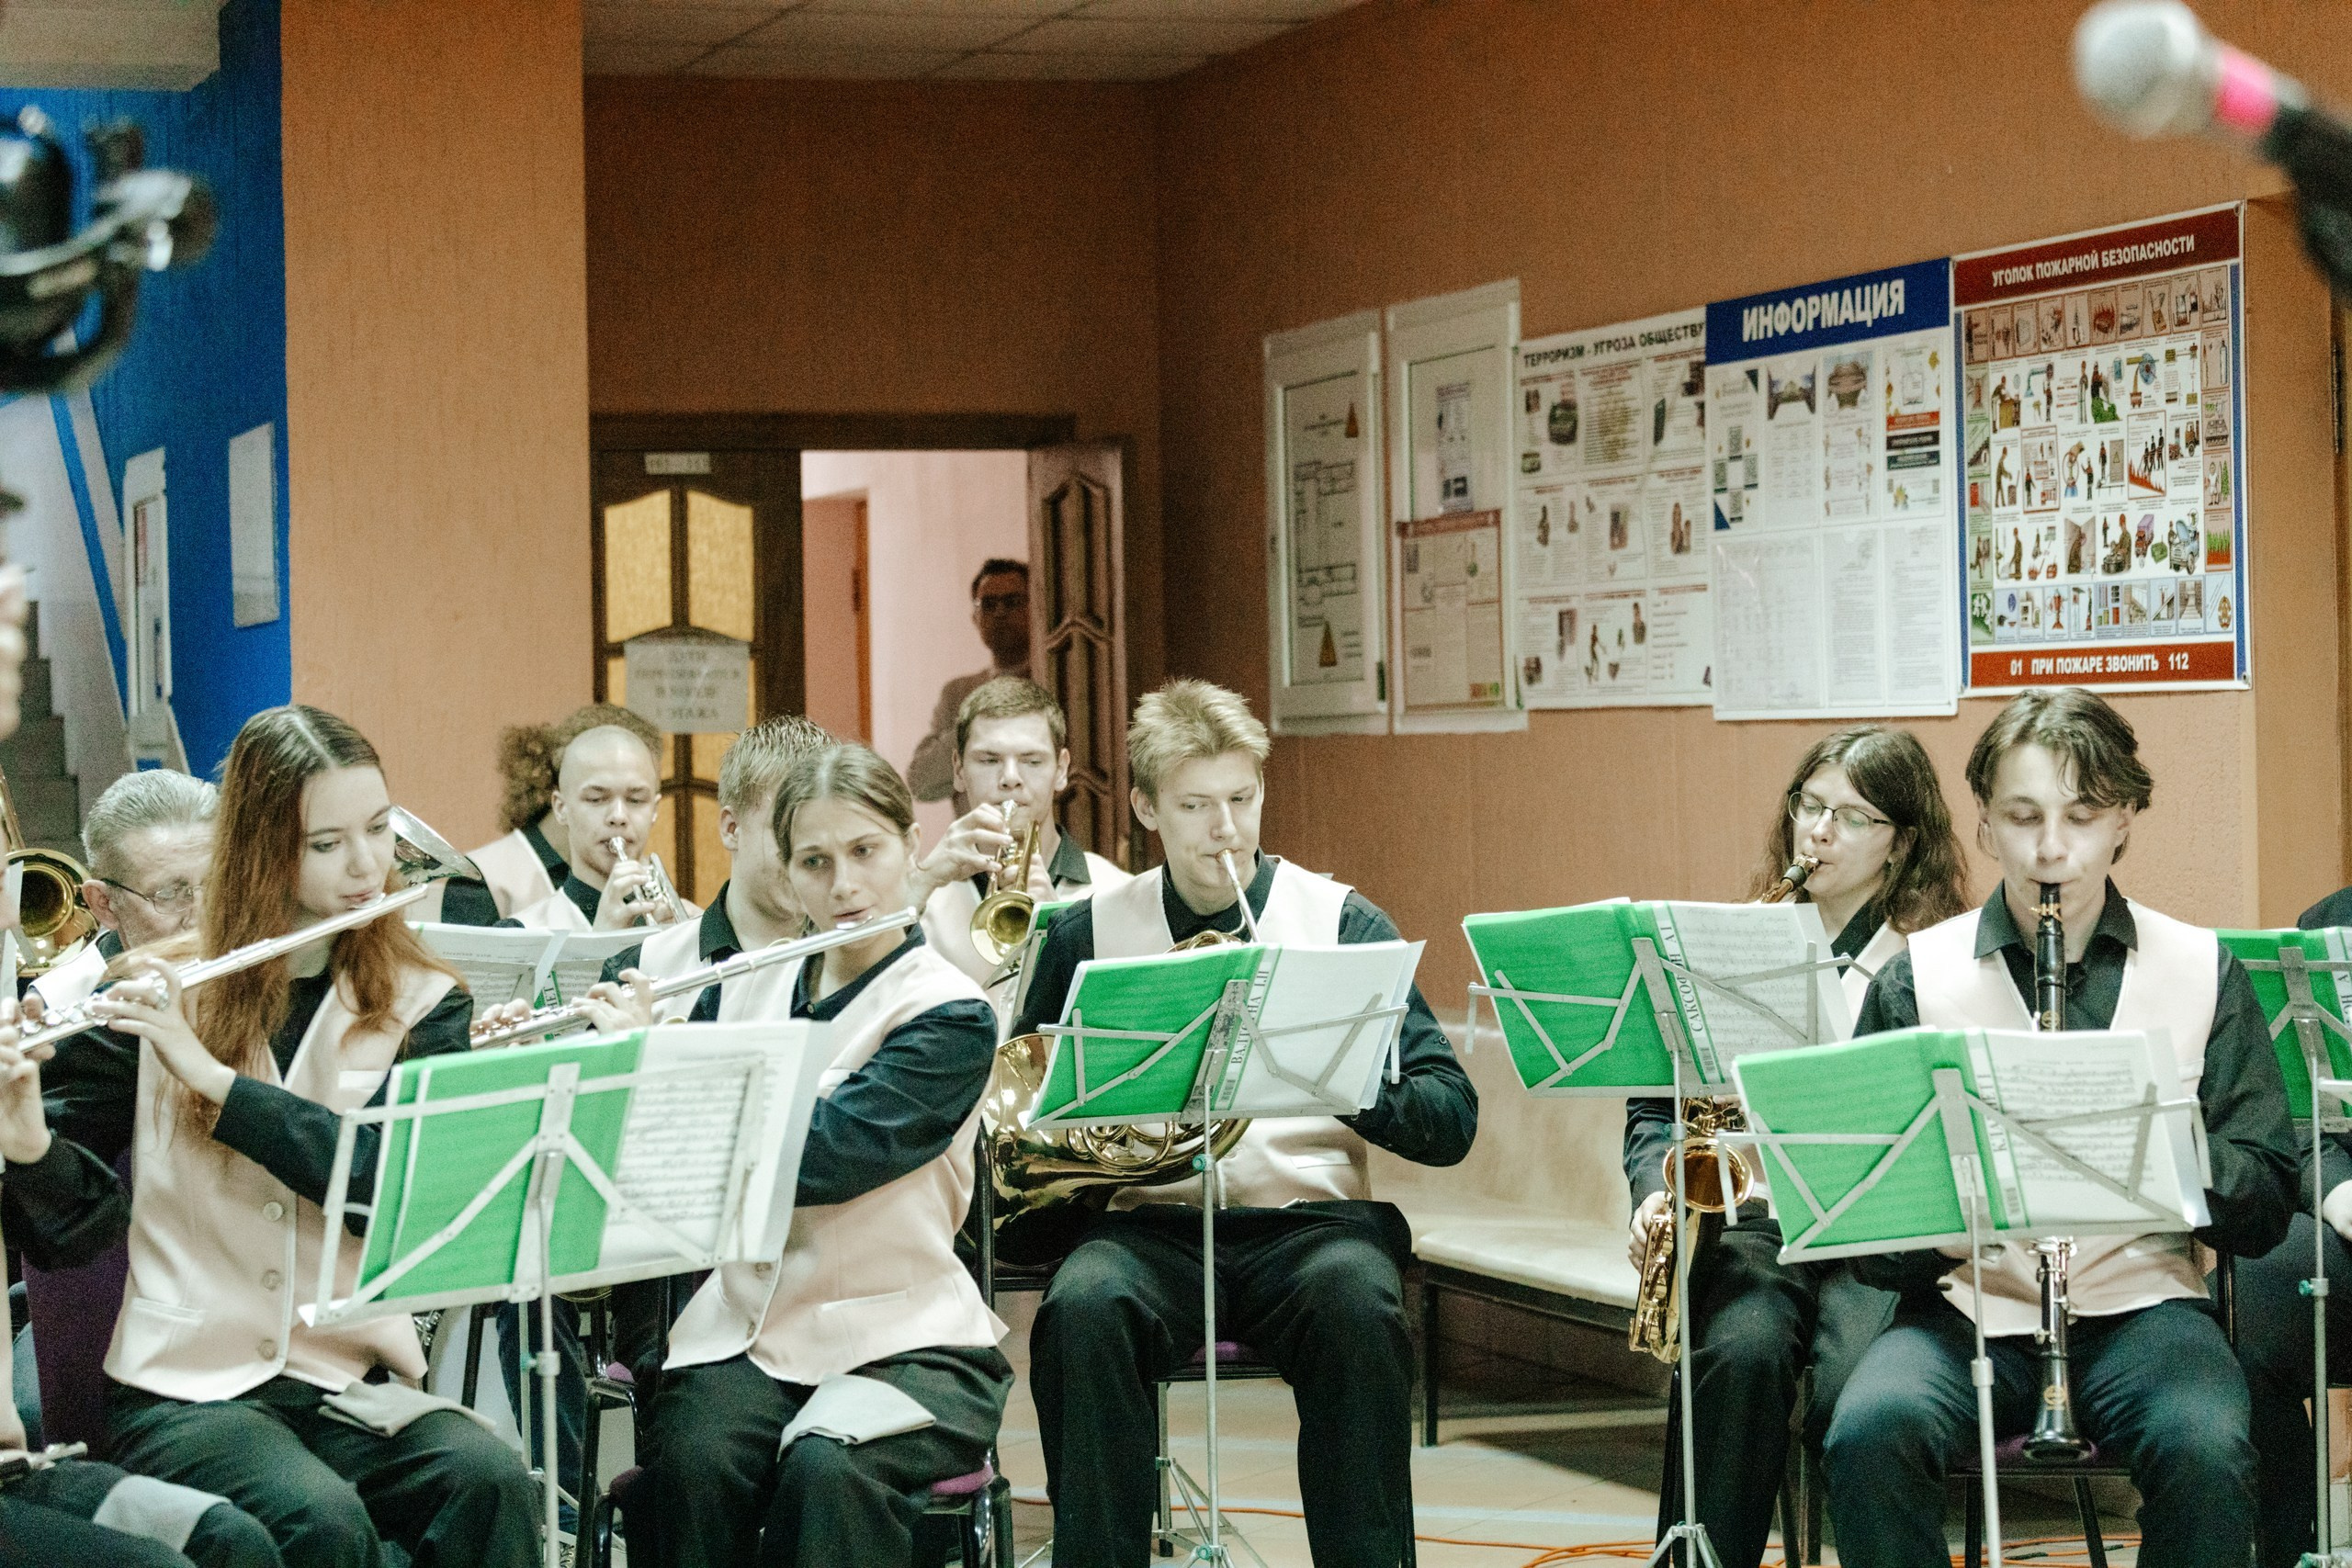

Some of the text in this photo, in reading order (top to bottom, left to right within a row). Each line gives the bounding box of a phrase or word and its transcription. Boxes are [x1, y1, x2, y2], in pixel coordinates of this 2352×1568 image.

[1992, 234, 2195, 288] УГОЛОК ПОЖАРНОЙ БЕЗОПАСНОСТИ
[1742, 278, 1905, 343] ИНФОРМАЦИЯ
[1523, 344, 1585, 367] ТЕРРОРИЗМ
[1593, 335, 1636, 356] УГРОЗА
[2010, 652, 2189, 676] 01 ПРИ ПОЖАРЕ ЗВОНИТЬ 112
